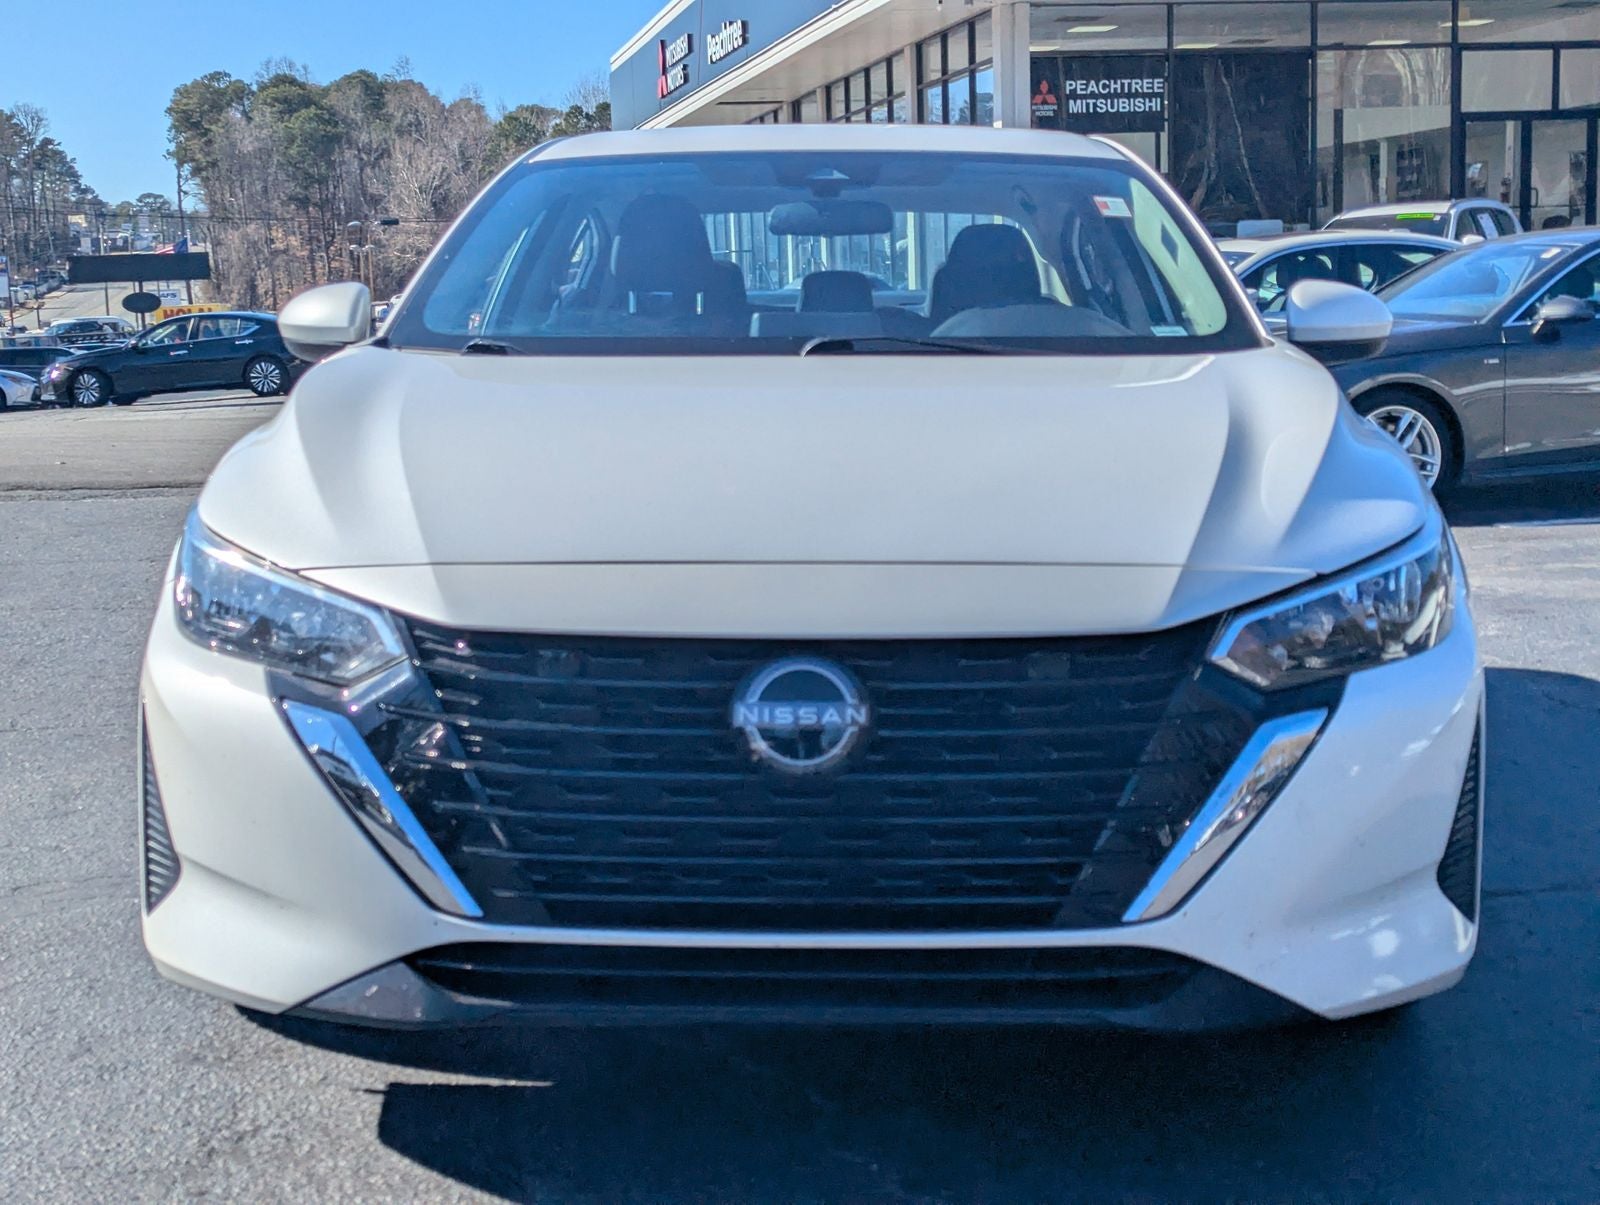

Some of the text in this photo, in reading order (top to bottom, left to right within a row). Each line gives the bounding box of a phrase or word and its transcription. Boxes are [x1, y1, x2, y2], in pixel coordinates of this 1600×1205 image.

[706, 19, 743, 65] Peachtree
[1065, 79, 1164, 95] PEACHTREE
[1068, 98, 1161, 113] MITSUBISHI
[738, 705, 867, 725] NISSAN
